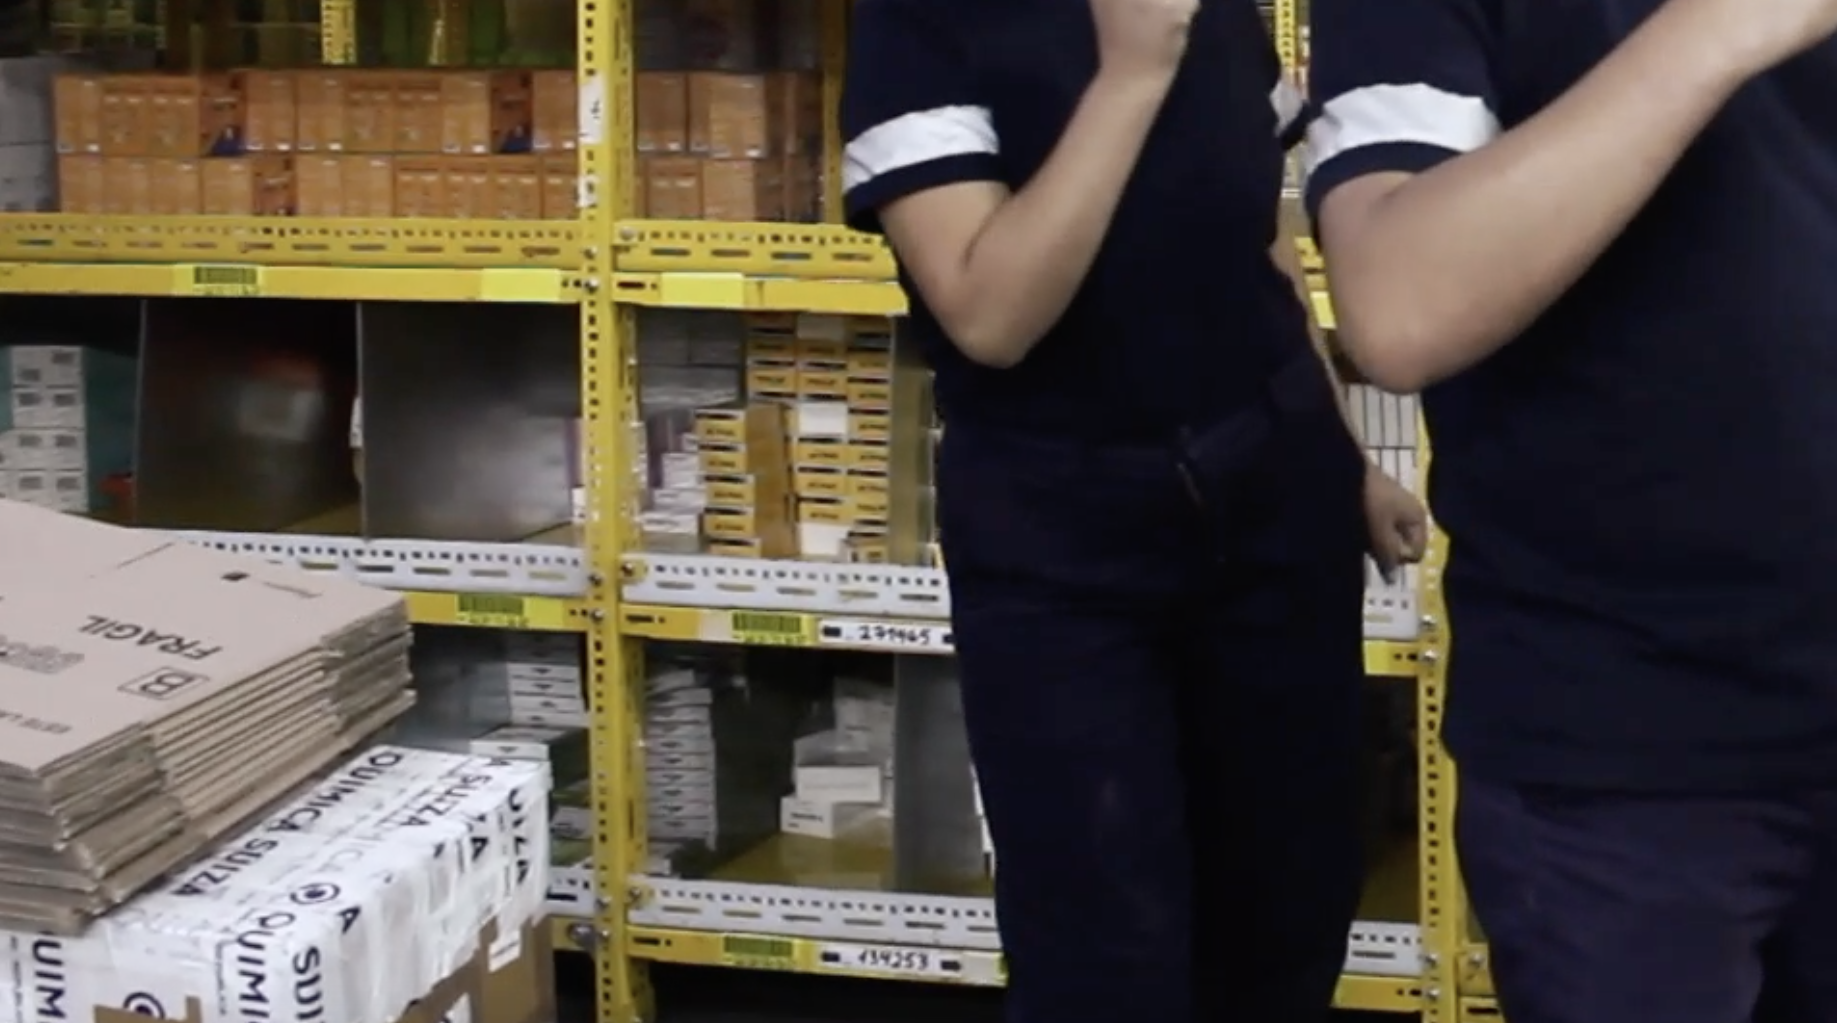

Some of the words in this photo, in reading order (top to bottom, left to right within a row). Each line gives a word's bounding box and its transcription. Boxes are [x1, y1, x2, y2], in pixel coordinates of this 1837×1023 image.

[79, 614, 223, 660] FRAGIL
[264, 751, 404, 833] QUIMICA
[400, 775, 494, 826] SUIZA
[171, 838, 279, 896] SUIZA
[32, 930, 67, 1023] UIM
[236, 911, 297, 1023] QUIMI
[292, 945, 324, 1023] SUI
